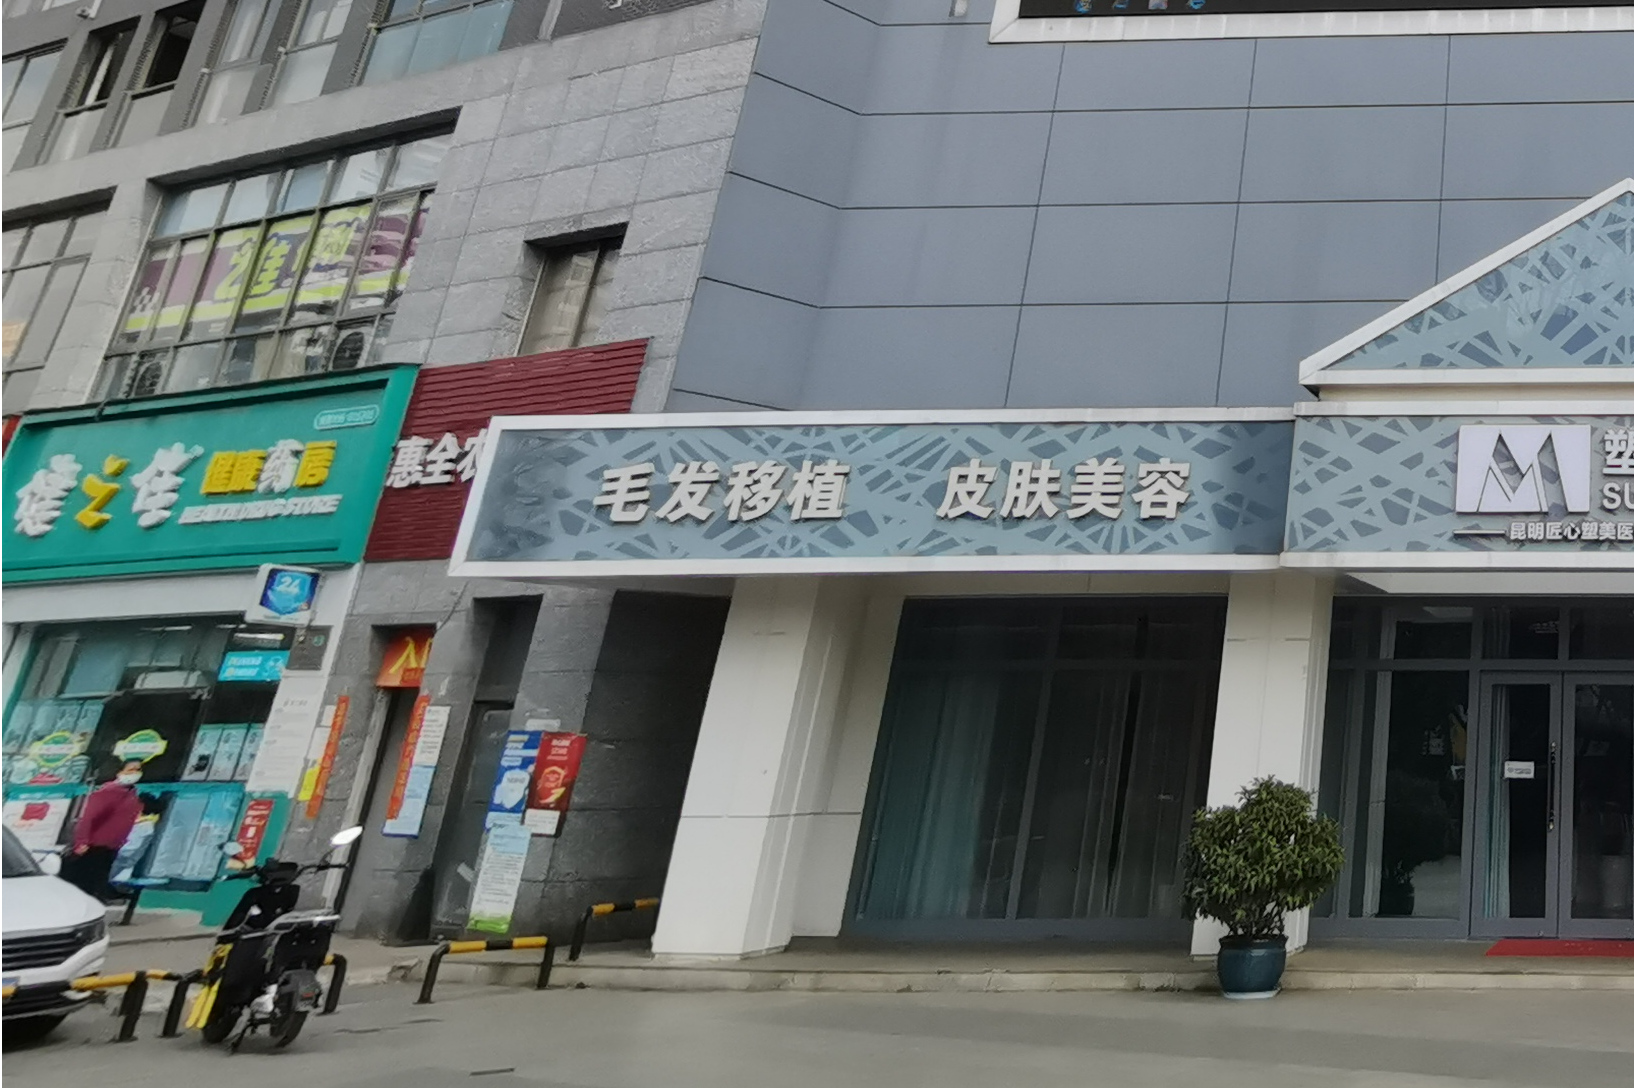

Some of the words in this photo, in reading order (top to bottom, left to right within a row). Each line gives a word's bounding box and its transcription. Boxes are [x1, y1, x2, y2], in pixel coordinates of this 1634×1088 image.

[593, 460, 850, 524] 毛发移植
[936, 458, 1191, 520] 皮肤美容
